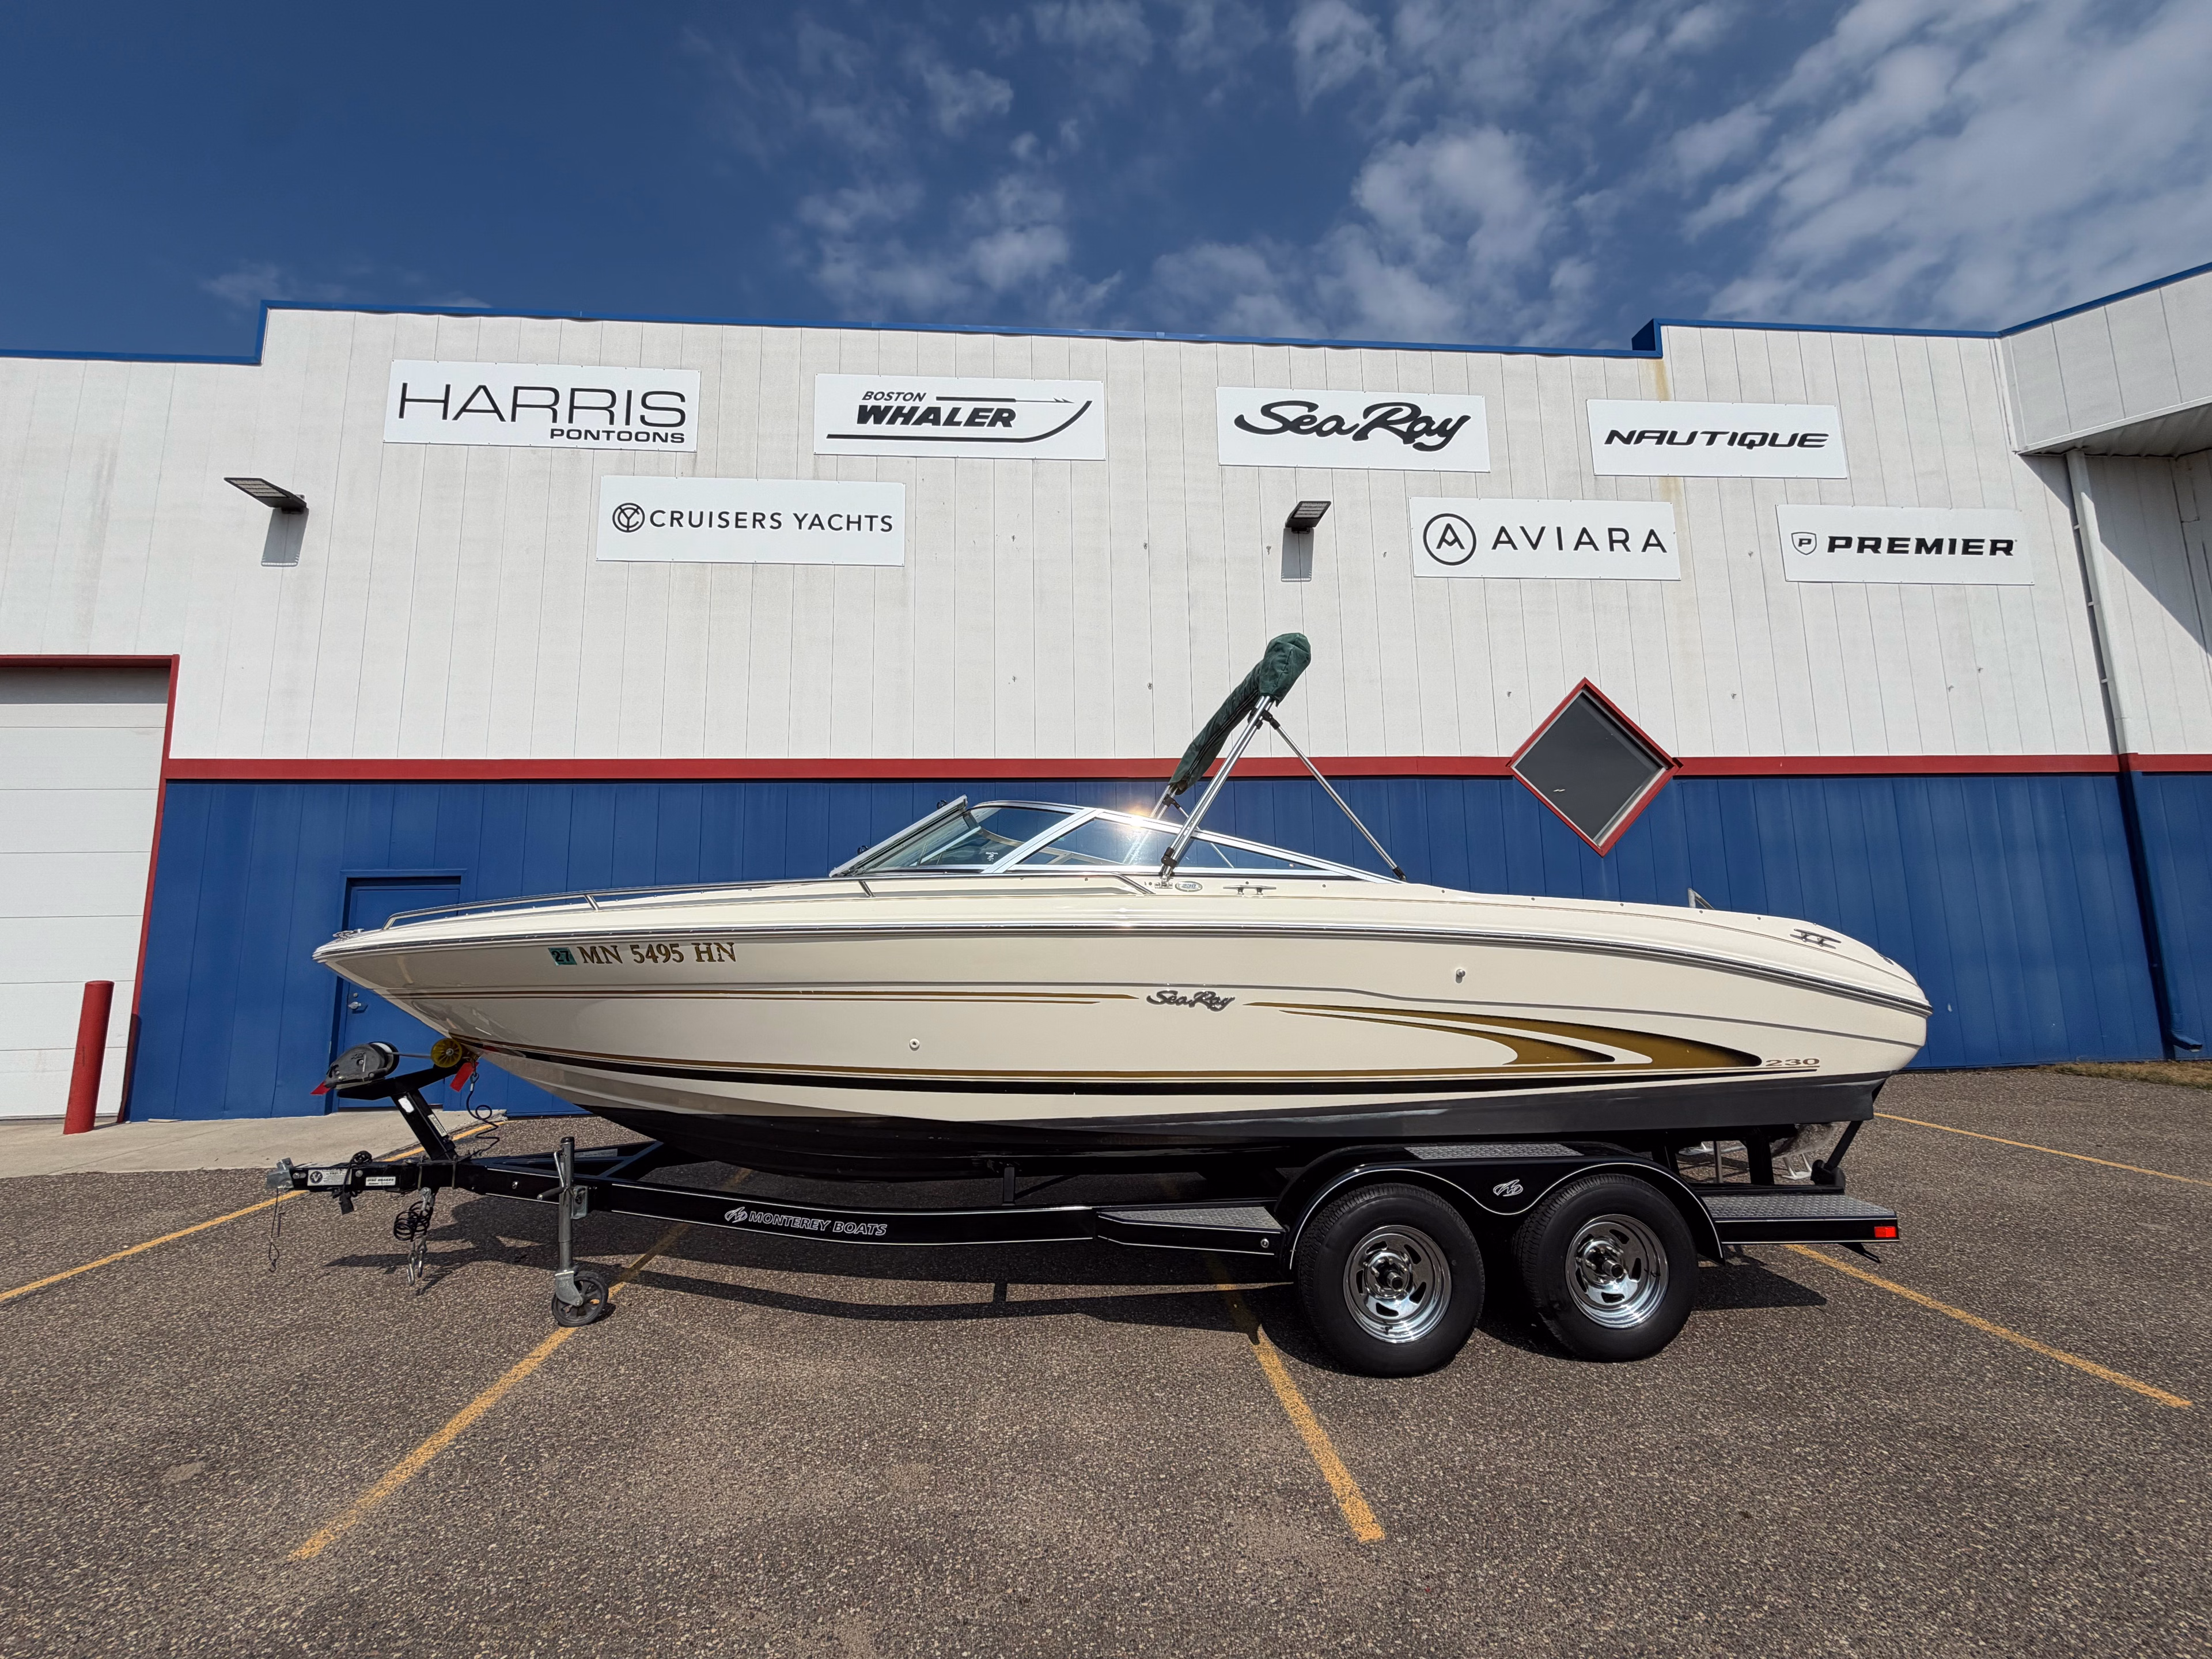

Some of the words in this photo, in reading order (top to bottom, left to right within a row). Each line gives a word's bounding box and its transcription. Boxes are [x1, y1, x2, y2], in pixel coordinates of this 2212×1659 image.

[399, 382, 685, 427] HARRIS
[862, 391, 926, 402] BOSTON
[857, 404, 1016, 427] WHALER
[1234, 400, 1360, 437] Sea
[1352, 402, 1471, 452] Ray
[550, 428, 684, 444] PONTOONS
[1604, 430, 1829, 450] NAUTIQUE
[650, 510, 782, 529] CRUISERS
[793, 513, 892, 532] YACHTS
[1491, 525, 1667, 553] AVIARA
[1798, 538, 1812, 547] P
[1827, 536, 2014, 556] PREMIER
[551, 950, 570, 962] 27
[577, 945, 623, 964] MN
[630, 943, 684, 964] 5495
[691, 942, 736, 963] HN
[1146, 990, 1192, 1006] Sea
[1188, 990, 1236, 1012] Ray
[1766, 1058, 1820, 1066] 230
[749, 1211, 831, 1231] MONTEREY
[832, 1221, 887, 1236] BOATS
